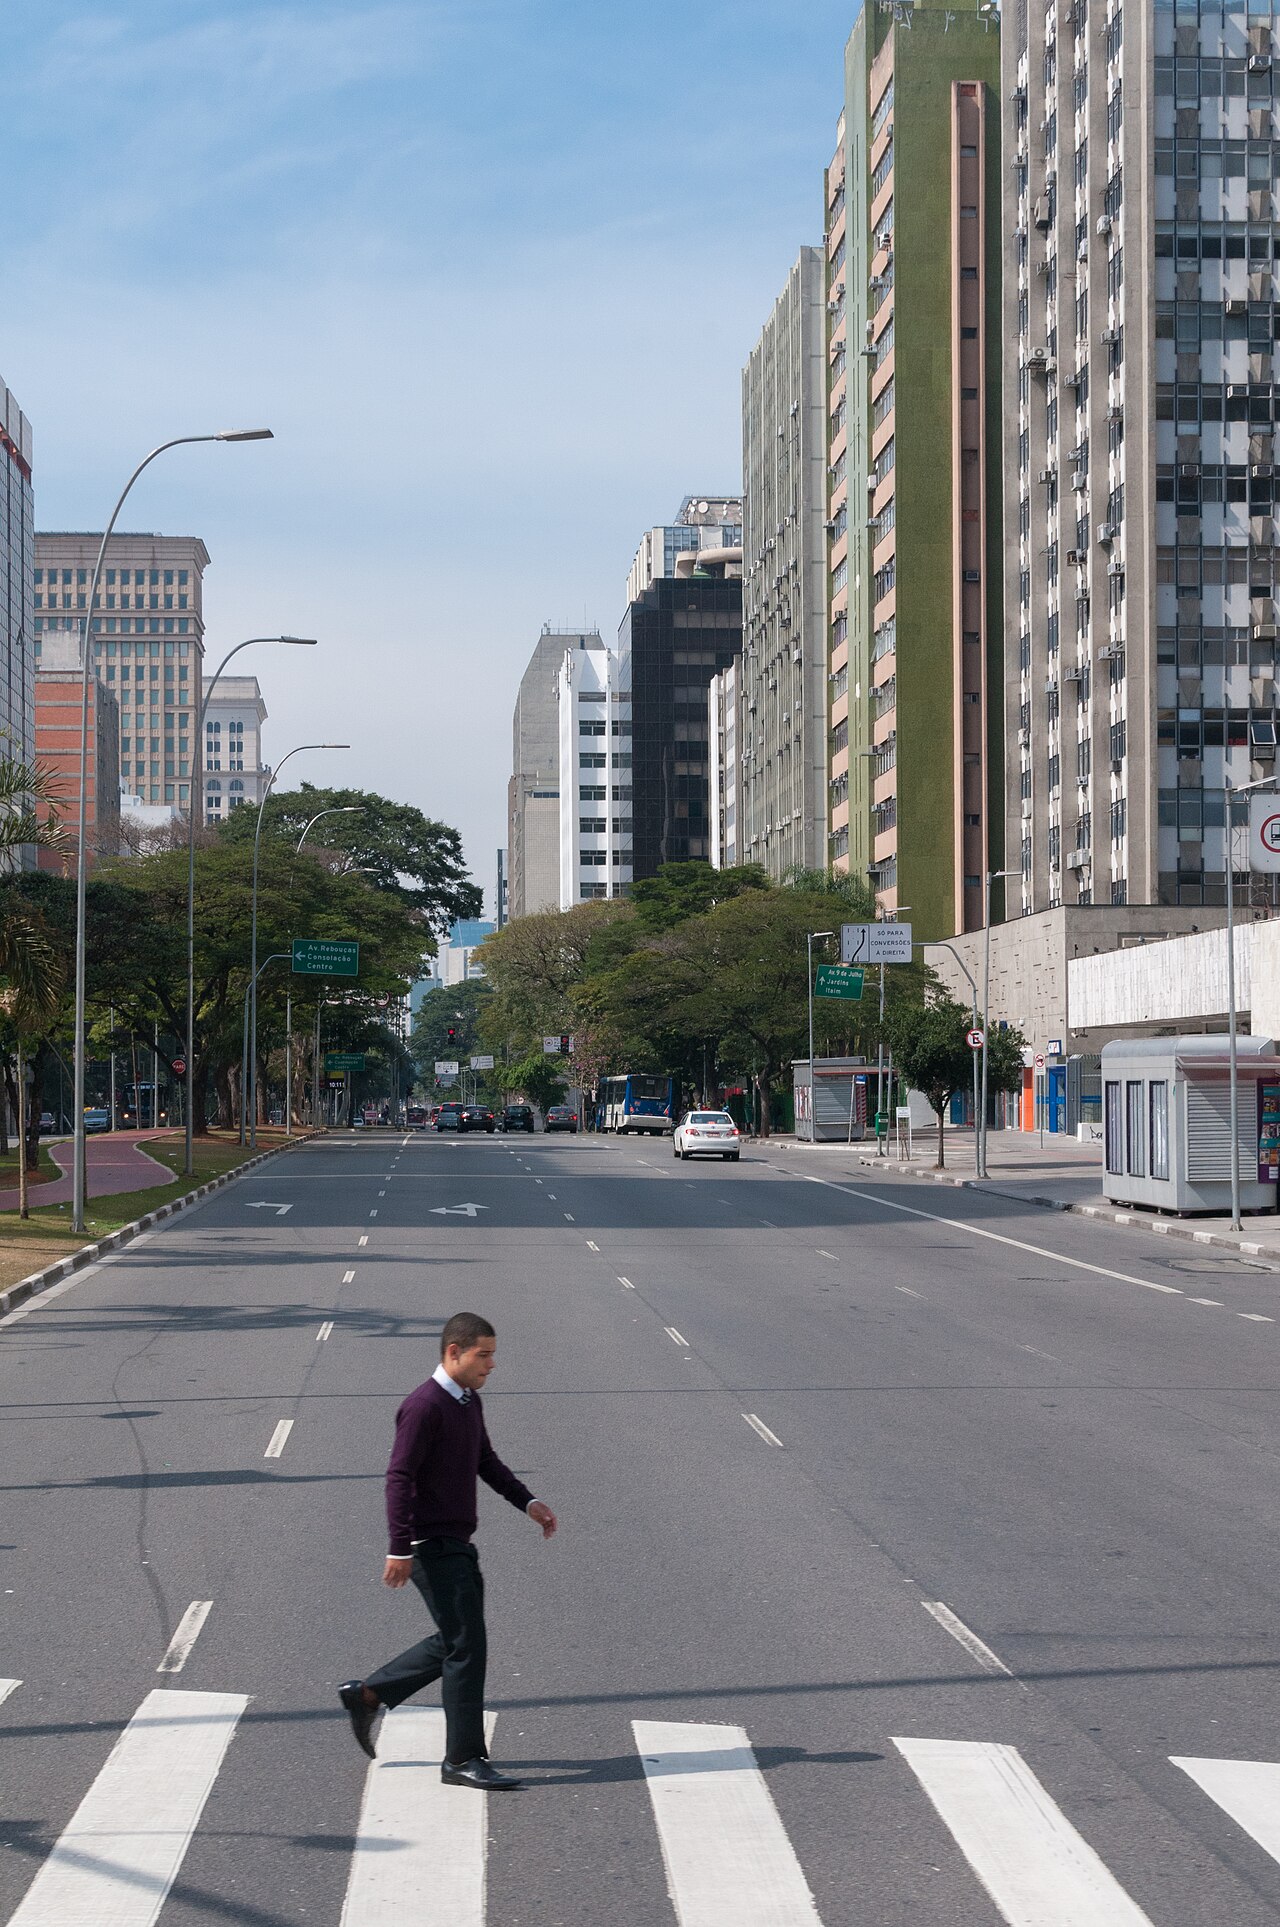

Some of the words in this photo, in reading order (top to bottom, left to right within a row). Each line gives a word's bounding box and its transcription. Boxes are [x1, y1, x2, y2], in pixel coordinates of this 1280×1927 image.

[320, 944, 357, 954] Rebouças
[307, 953, 351, 962] Consolação
[306, 962, 334, 970] Centro
[848, 970, 863, 978] Julho
[826, 978, 849, 987] Jardins
